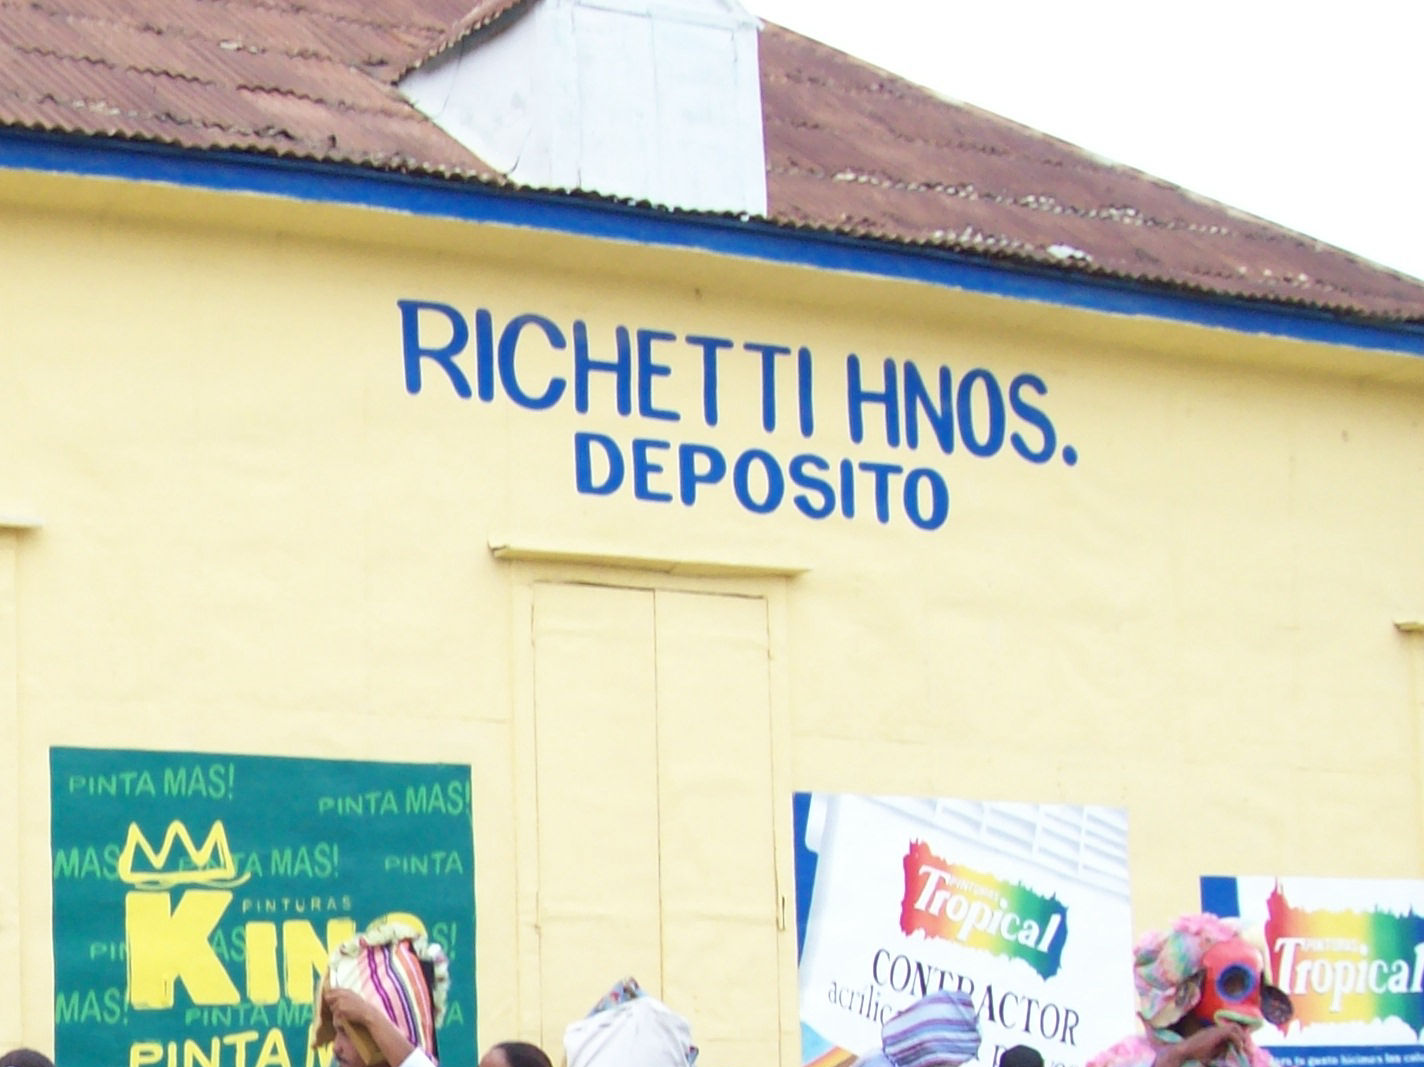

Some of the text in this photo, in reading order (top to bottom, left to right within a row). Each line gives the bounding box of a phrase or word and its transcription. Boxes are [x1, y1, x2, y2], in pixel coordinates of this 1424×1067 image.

[397, 299, 1078, 466] RICHETTI HNOS.
[576, 431, 950, 532] DEPOSITO
[69, 762, 236, 801] PINTA MAS!
[317, 780, 471, 816] PINTA MAS!
[270, 841, 339, 879] MAS!
[384, 849, 464, 875] PINTA
[241, 894, 352, 913] PINTURAS
[914, 864, 1062, 954] Tropical
[125, 891, 428, 1009] KIN
[1274, 935, 1424, 1014] Tropical
[55, 987, 130, 1025] MAS!
[185, 1002, 269, 1027] PINTA
[872, 948, 1080, 1047] CONTRACTOR
